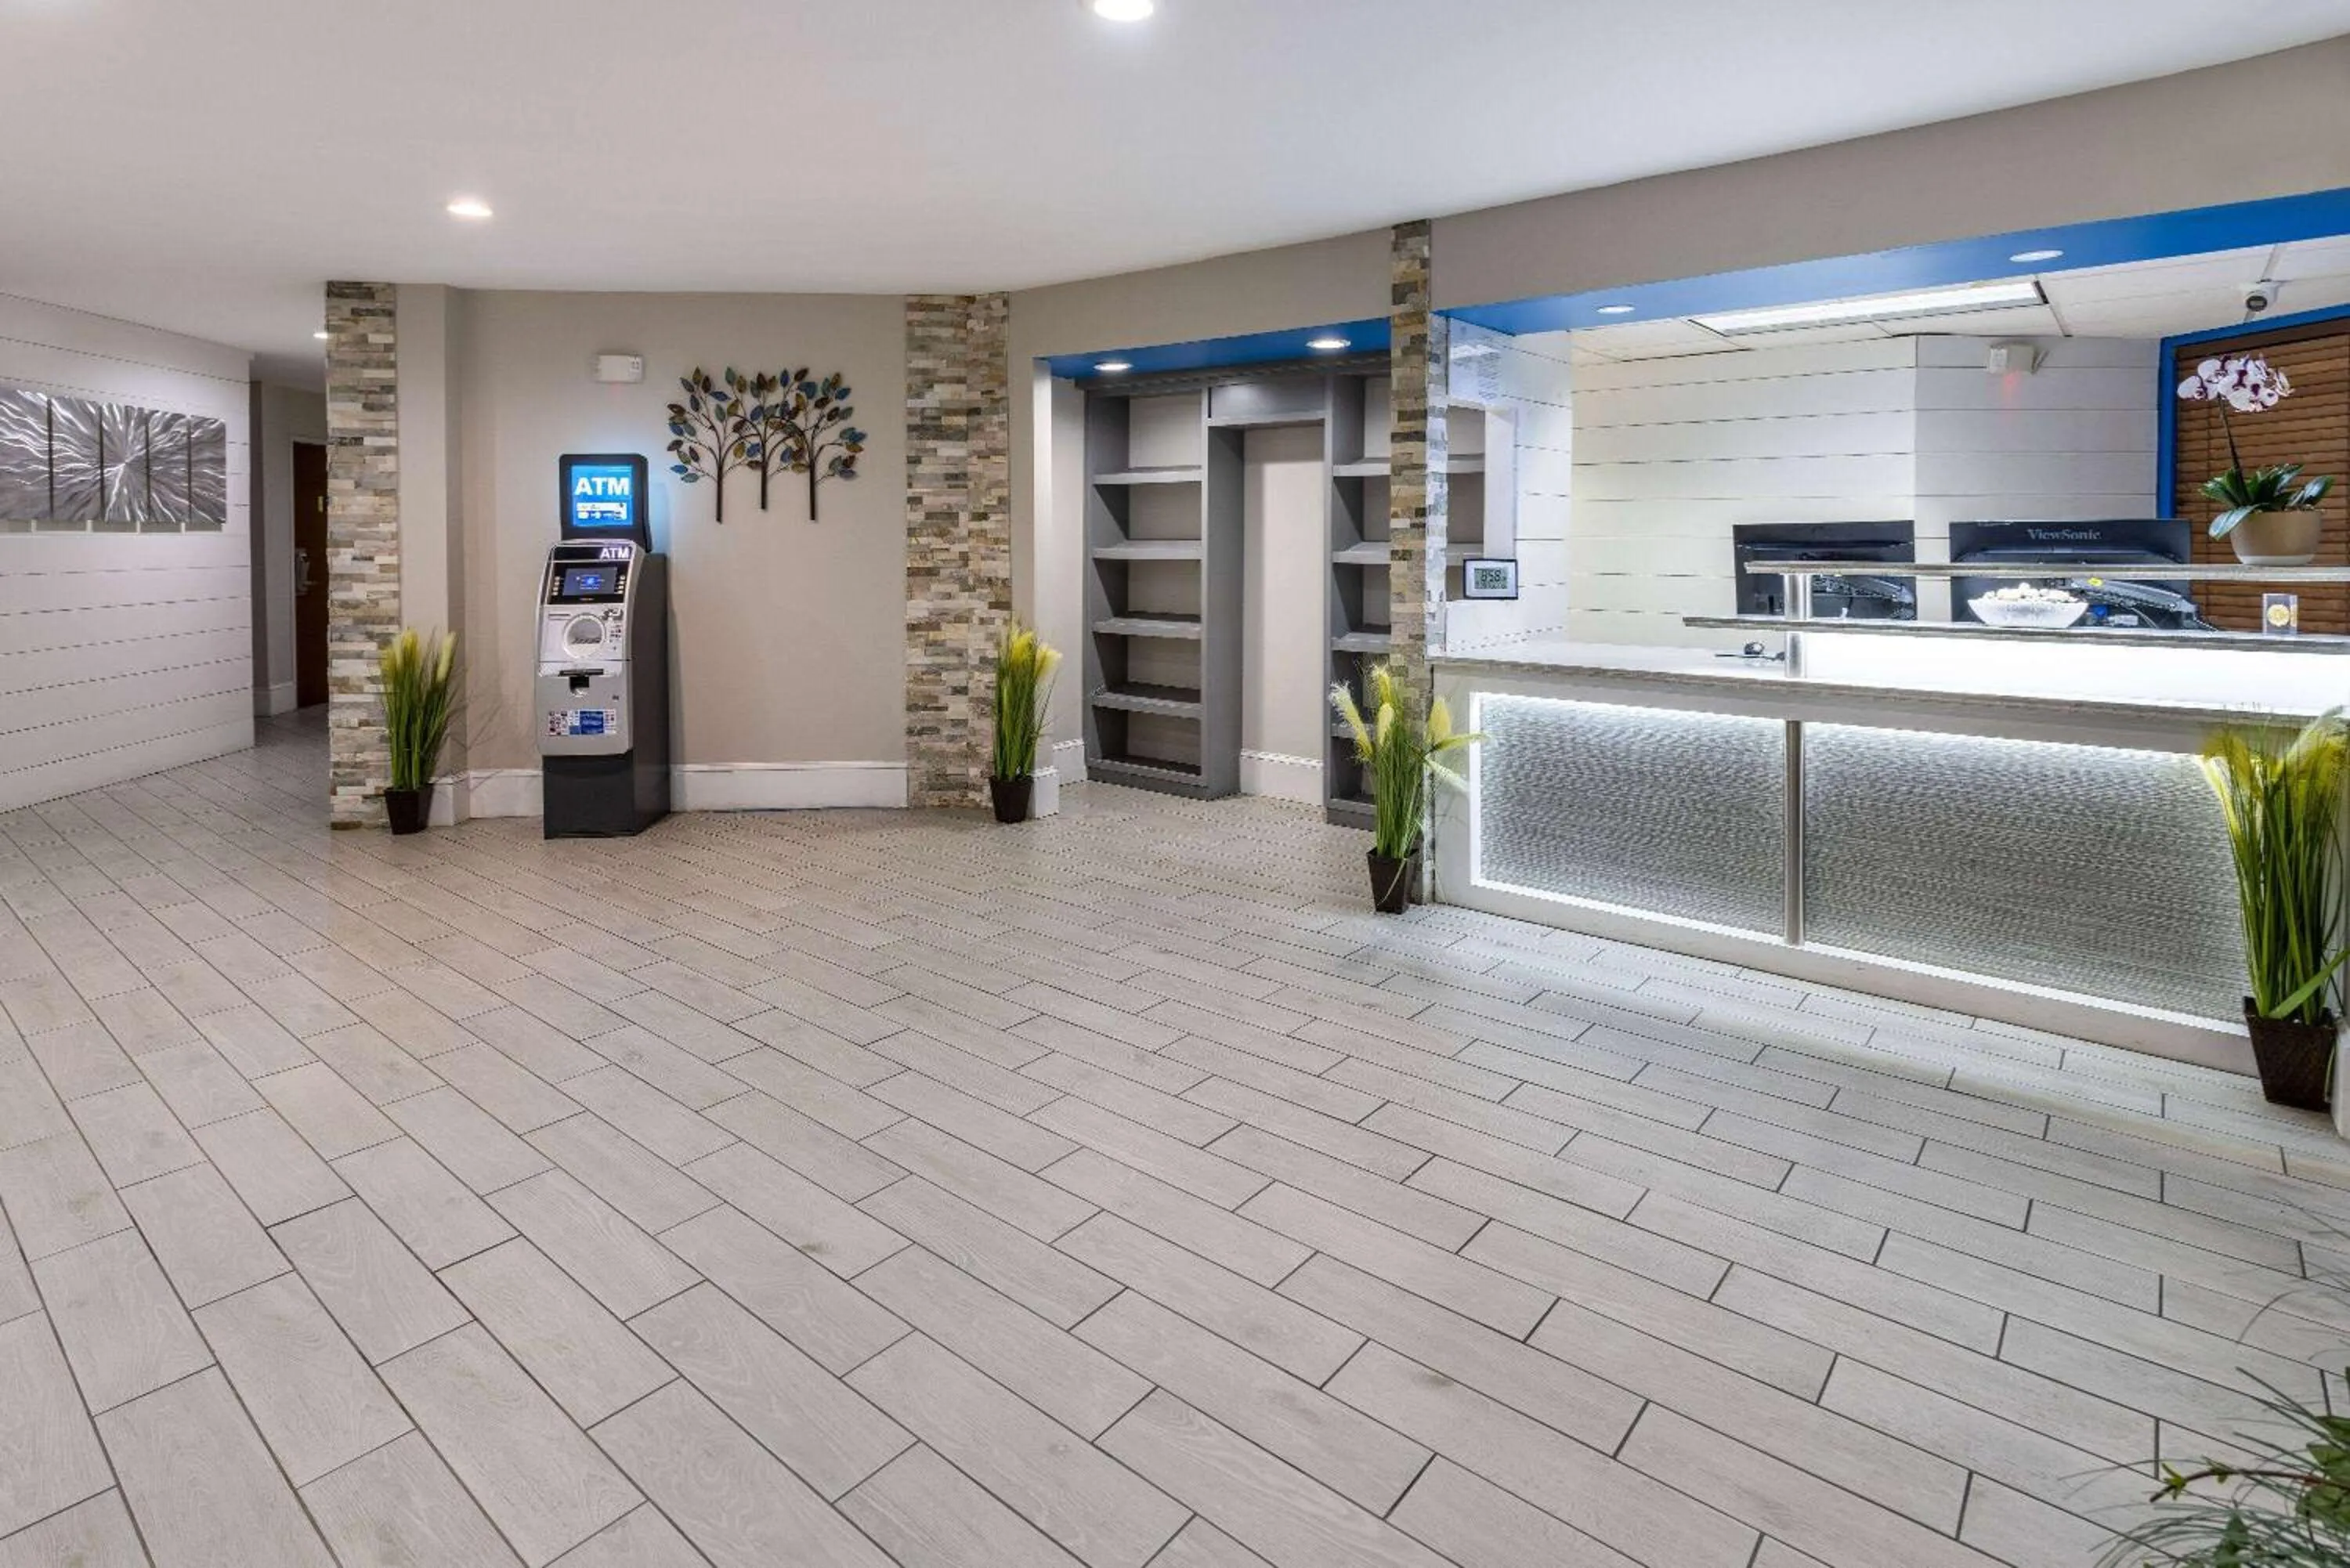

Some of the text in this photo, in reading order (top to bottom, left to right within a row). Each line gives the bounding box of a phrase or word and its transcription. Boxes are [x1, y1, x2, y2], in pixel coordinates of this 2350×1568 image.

[575, 477, 629, 495] ATM
[2027, 529, 2102, 540] ViewSonic
[600, 547, 630, 558] ATM
